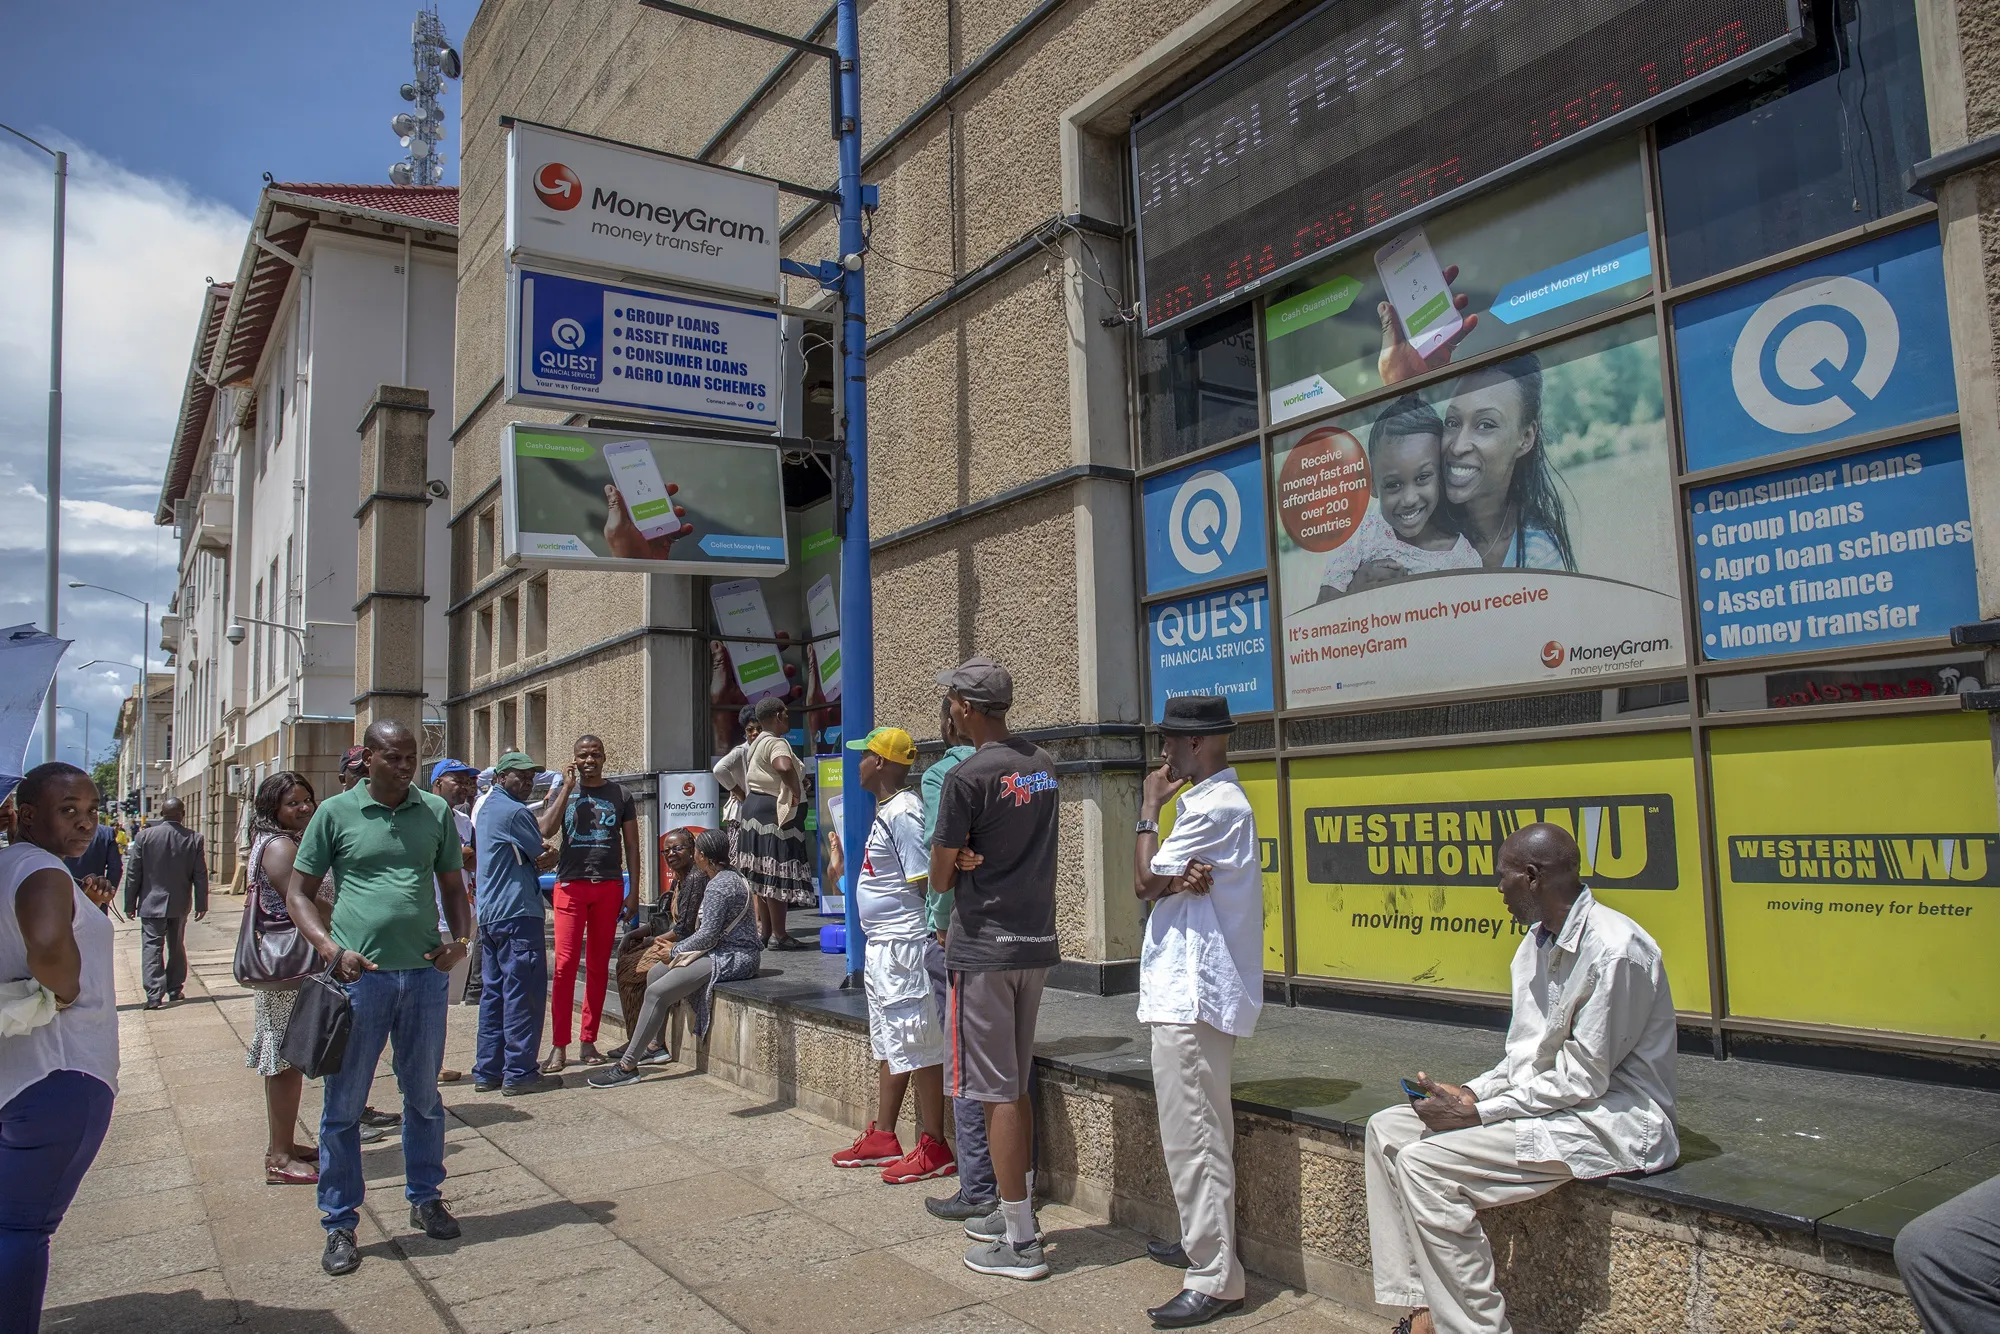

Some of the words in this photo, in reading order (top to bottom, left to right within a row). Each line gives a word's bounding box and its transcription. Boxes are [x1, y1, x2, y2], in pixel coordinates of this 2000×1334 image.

[1287, 21, 1404, 125] FEES
[590, 187, 766, 244] MoneyGram
[591, 221, 653, 247] money
[656, 232, 724, 257] transfer
[1510, 284, 1549, 306] Collect
[1551, 271, 1590, 293] Money
[1591, 260, 1620, 277] Here
[1281, 308, 1301, 322] Cash
[1302, 286, 1349, 314] Guaranteed
[626, 307, 674, 326] GROUP
[677, 316, 720, 335] LOANS
[625, 327, 669, 346] ASSET
[672, 334, 728, 355] FINANCE
[540, 351, 597, 372] QUEST
[541, 367, 570, 377] FINANCIAL
[571, 371, 596, 380] SERVICES
[625, 346, 702, 370] CONSUMER
[706, 358, 748, 376] LOANS
[535, 380, 553, 389] Your
[555, 383, 569, 391] way
[571, 383, 600, 393] forward
[624, 366, 663, 383] AGRO
[667, 372, 700, 389] LOAN
[704, 376, 766, 398] SCHEMES
[1283, 386, 1324, 407] worldremit
[525, 441, 544, 449] Cash
[544, 443, 585, 453] Guaranteed
[1301, 450, 1342, 470] Receive
[1283, 473, 1318, 493] money
[1319, 465, 1341, 482] fast
[1343, 458, 1365, 476] and
[1708, 470, 1837, 514] Consumer
[1842, 453, 1923, 488] loans
[1282, 485, 1338, 509] affordable
[1339, 476, 1367, 495] from
[1301, 506, 1324, 521] over
[1326, 498, 1349, 515] 200
[1300, 517, 1352, 538] countries
[1711, 515, 1784, 548] Group
[1789, 501, 1864, 534] loans
[537, 540, 579, 552] worldremit
[710, 541, 733, 549] Collect
[734, 543, 755, 551] Money
[1715, 554, 1770, 581] Agro
[1775, 543, 1833, 572] loan
[1839, 519, 1972, 561] schemes
[1717, 582, 1786, 615] Asset
[1789, 570, 1893, 605] finance
[1156, 588, 1265, 647] QUEST
[1288, 627, 1309, 642] It's
[1311, 617, 1369, 638] amazing
[1371, 612, 1402, 628] how
[1404, 601, 1448, 623] much
[1451, 599, 1481, 619] you
[1484, 587, 1549, 611] receive
[1720, 620, 1801, 649] Money
[1806, 605, 1920, 639] transfer
[1160, 646, 1214, 669] FINANCIAL
[1216, 637, 1265, 660] SERVICES
[1289, 645, 1320, 665] with
[1321, 636, 1408, 661] MoneyGram
[1569, 635, 1669, 662] MoneyGram
[1570, 664, 1603, 677] money
[1604, 658, 1645, 672] transfer
[1214, 677, 1257, 695] forward
[1292, 685, 1332, 694] moneygram.com
[663, 802, 714, 812] MoneyGram
[1313, 810, 1492, 843] WESTERN
[1367, 845, 1494, 876] UNION
[1735, 839, 1874, 858] WESTERN
[1779, 860, 1877, 879] UNION
[1767, 898, 1823, 913] moving
[1829, 902, 1884, 917] money
[1889, 901, 1913, 915] for
[1918, 902, 1973, 917] better
[1351, 911, 1424, 935] moving
[1430, 916, 1503, 939] money
[1510, 917, 1529, 936] fo
